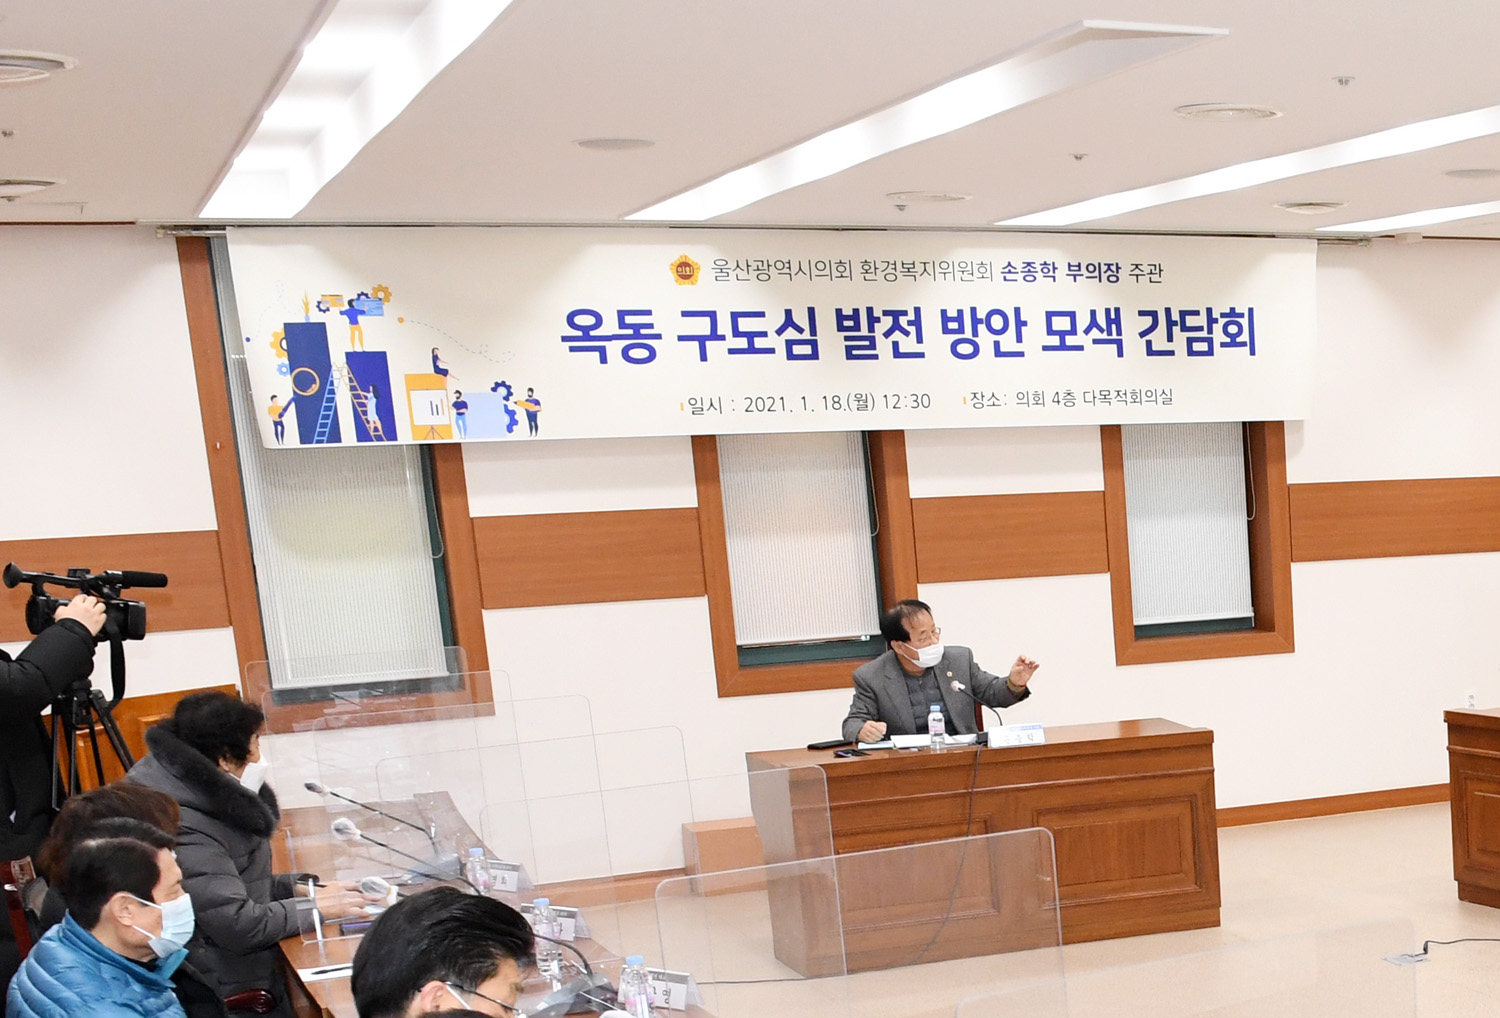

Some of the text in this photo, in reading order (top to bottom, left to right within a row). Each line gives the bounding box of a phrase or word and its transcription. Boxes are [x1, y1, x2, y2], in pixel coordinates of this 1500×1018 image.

[711, 258, 1164, 285] 울산광역시의회 환경복지위원회 손종학 부의장 주관
[560, 306, 1257, 365] 옥동 구도심 발전 방안 모색 간담회
[687, 396, 723, 416] 일시
[744, 395, 794, 413] 2021.
[822, 391, 876, 413] 18.(월)
[882, 392, 932, 410] 12:30
[970, 388, 1174, 410] 장소: 의회 4층 다목적회의실
